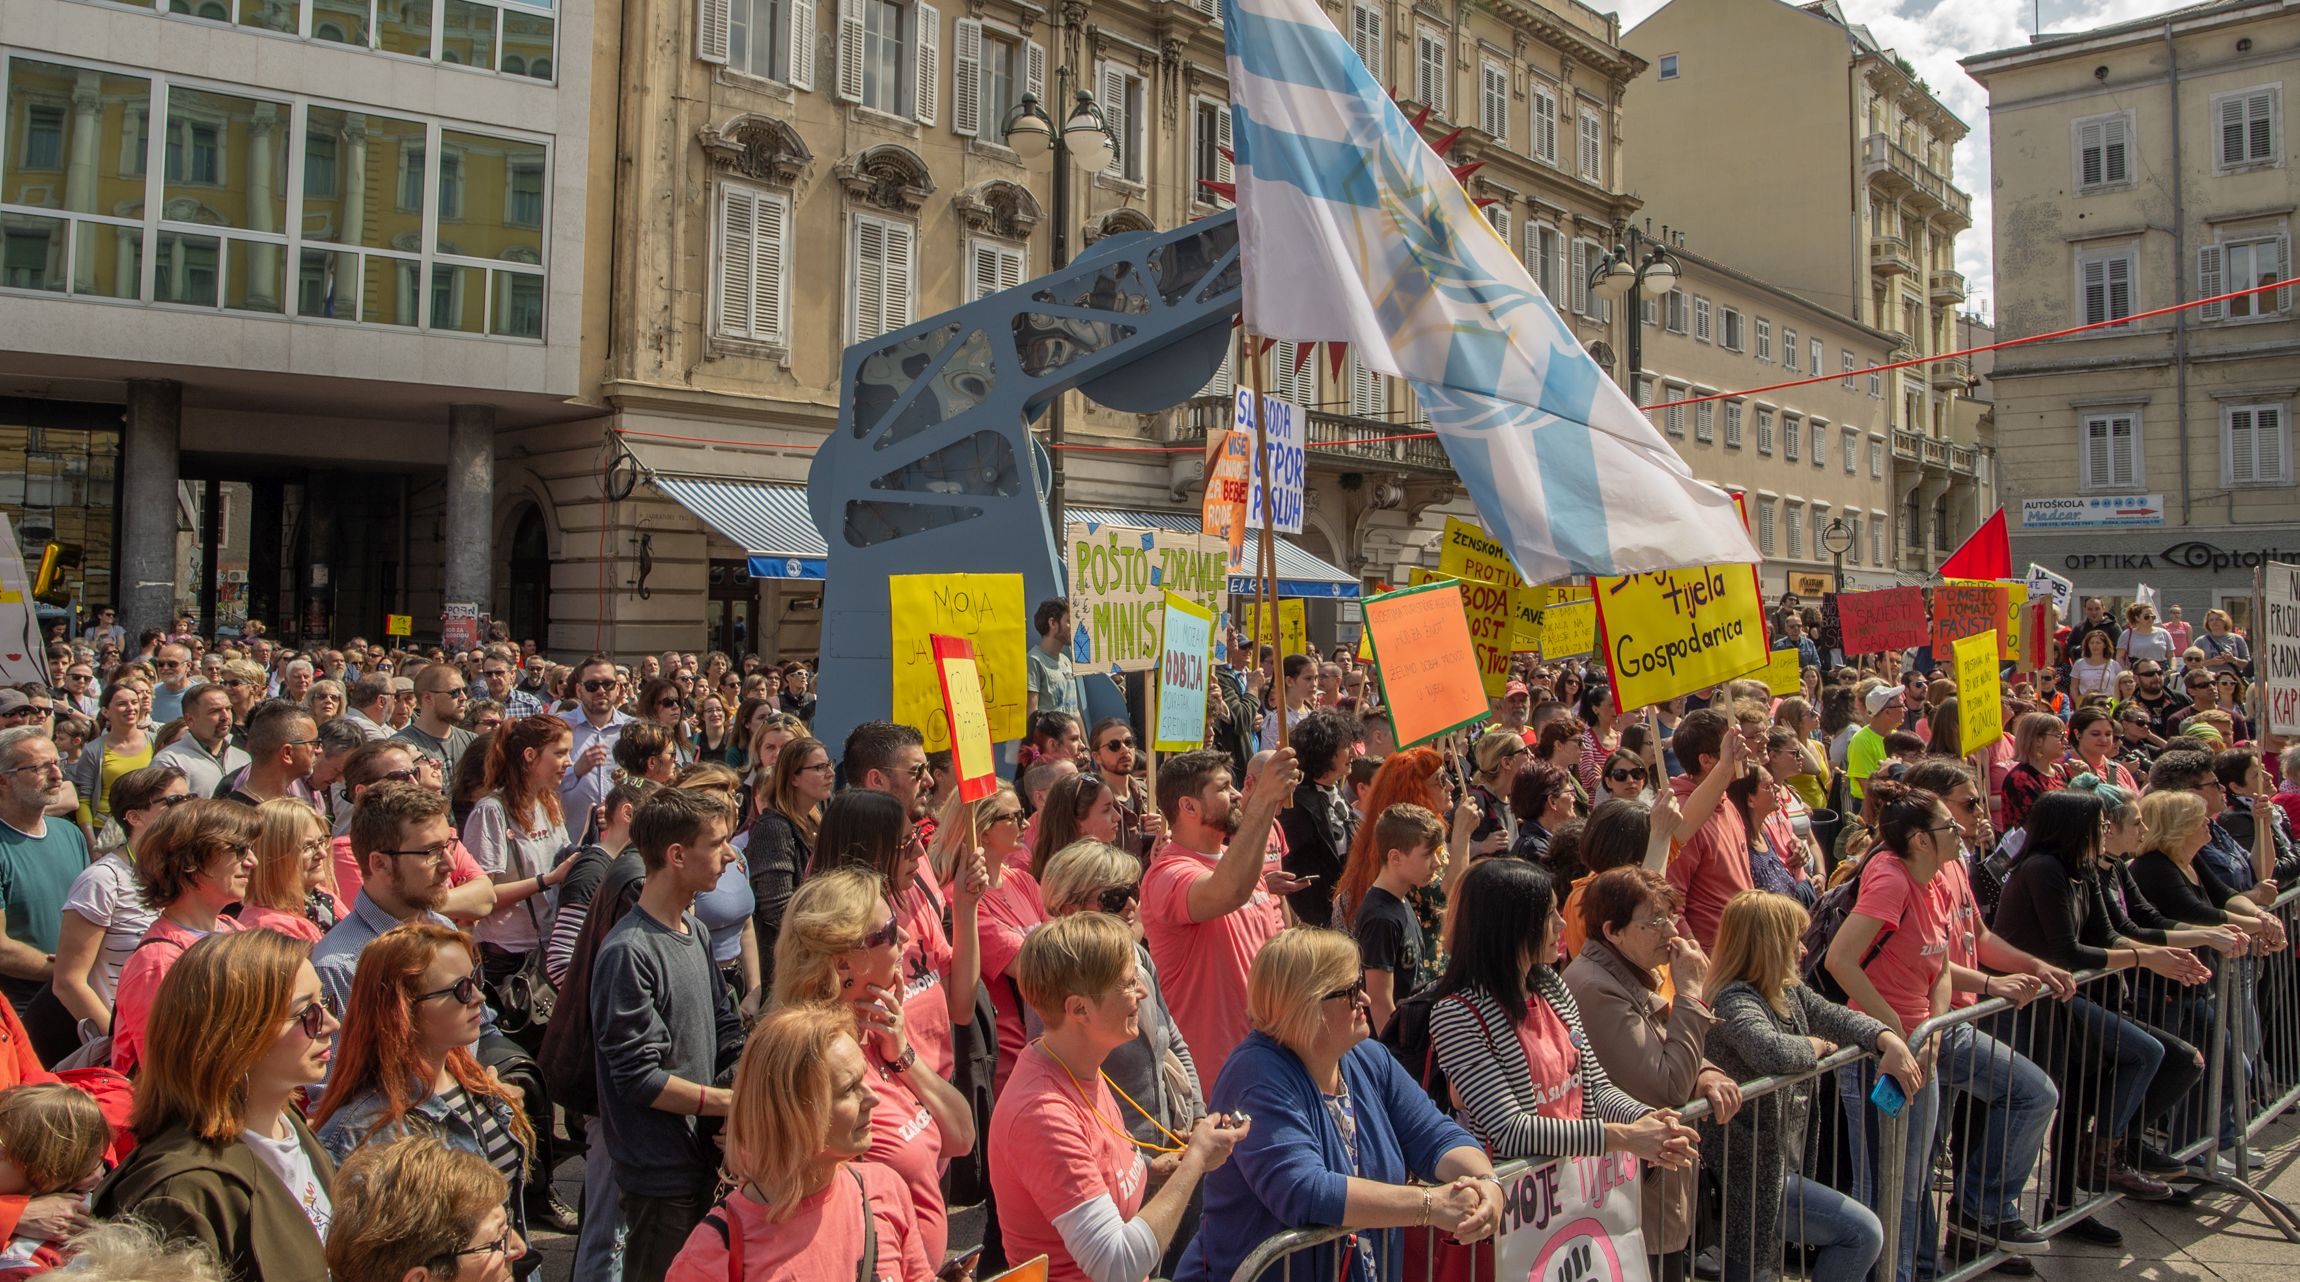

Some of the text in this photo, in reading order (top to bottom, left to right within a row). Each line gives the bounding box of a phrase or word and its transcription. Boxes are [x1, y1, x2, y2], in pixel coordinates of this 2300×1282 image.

[1237, 390, 1291, 440] SLBODA
[1228, 432, 1249, 457] VIŠE
[1222, 480, 1249, 504] BEBE
[2025, 500, 2084, 509] AUTOŠKOLA
[1452, 528, 1504, 558] ŽENSKOM
[1076, 531, 1148, 595] POŠTO
[1465, 558, 1521, 588] PROTIV
[2065, 555, 2153, 569] OPTIKA
[1230, 579, 1244, 593] El
[1662, 566, 1726, 618] tijela
[1937, 589, 1996, 600] TOMEJTO
[2290, 570, 2300, 601] N
[934, 585, 997, 635] MOJA
[1947, 603, 1998, 616] TOMATO
[2271, 603, 2300, 639] PRISIL
[1617, 619, 1742, 678] Gospodarica
[2271, 643, 2300, 679] RADN
[1165, 649, 1203, 692] ODBIJA
[2273, 687, 2300, 725] KAP
[1500, 1152, 1637, 1236] MOJE TIJELO
